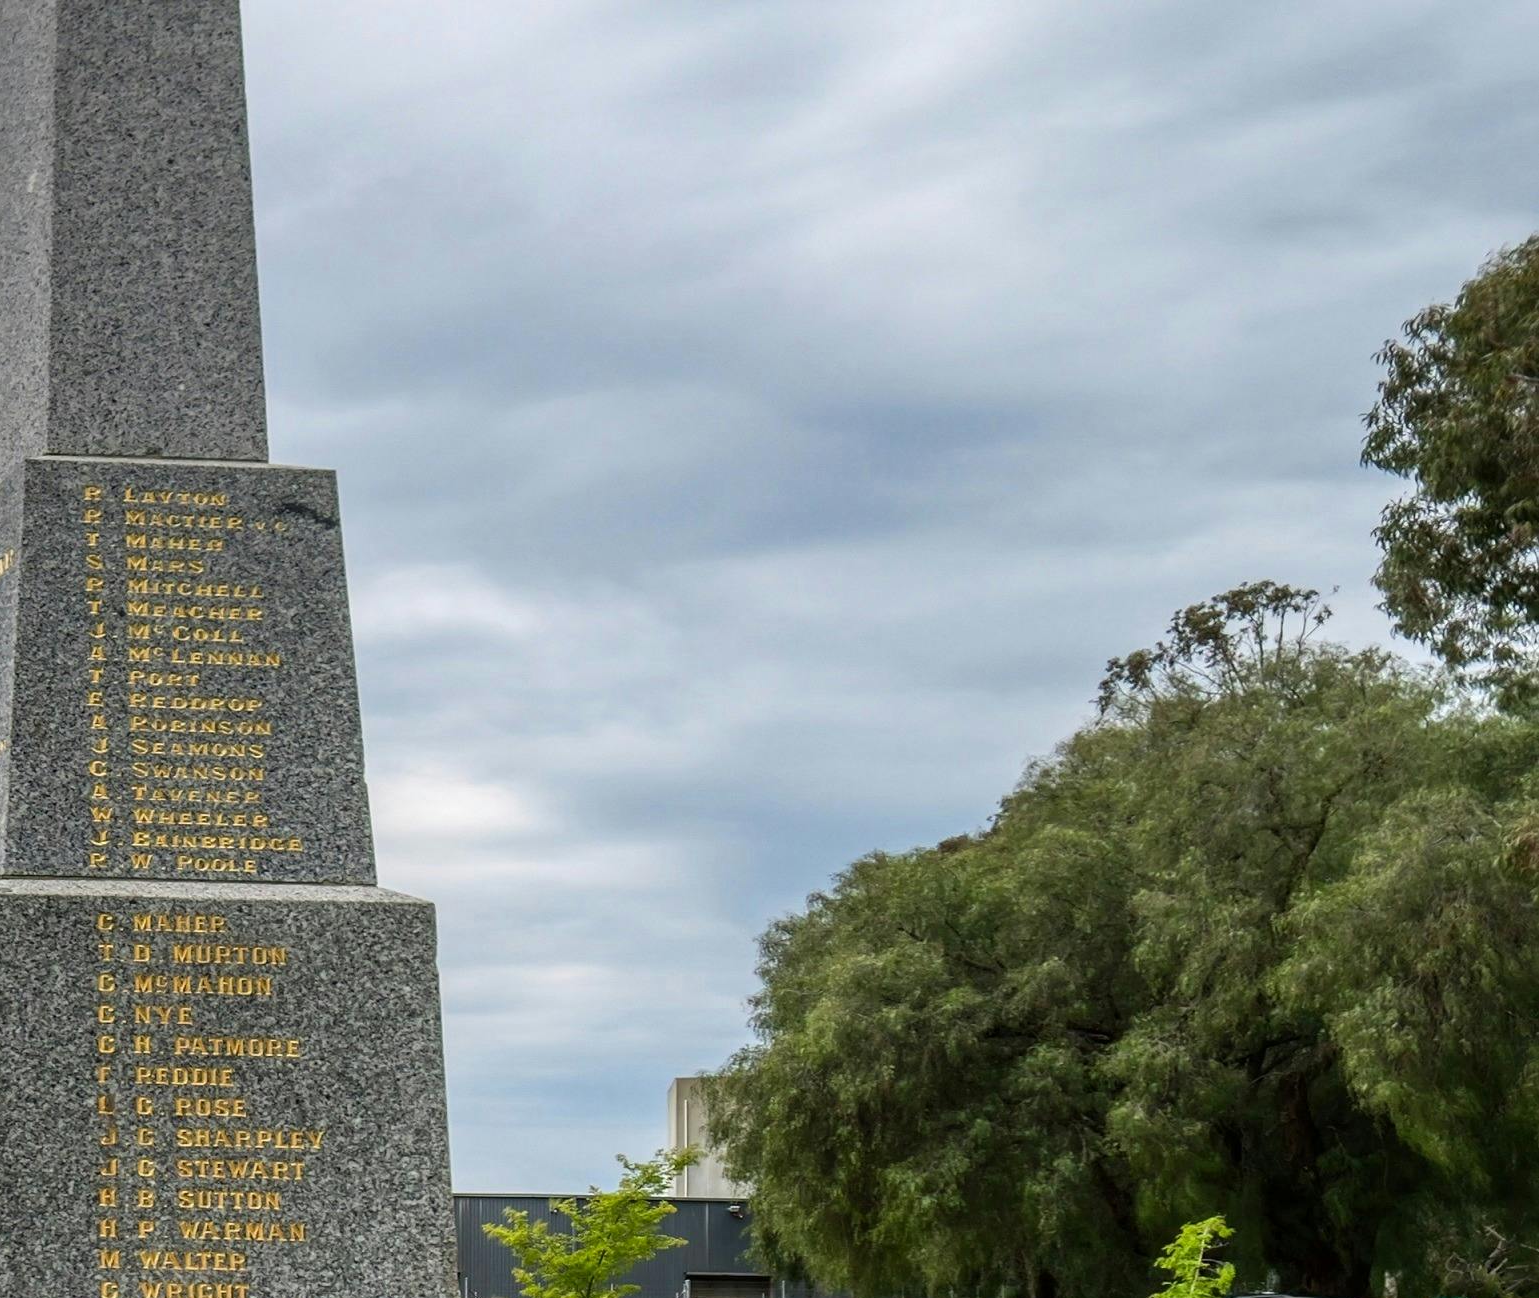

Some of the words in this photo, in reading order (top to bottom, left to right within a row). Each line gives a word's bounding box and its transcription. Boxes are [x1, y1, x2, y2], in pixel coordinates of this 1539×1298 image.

[124, 487, 228, 506] LAYTON
[125, 510, 244, 531] MACTIER
[126, 533, 224, 550] MAHER
[126, 556, 205, 574] MARS
[127, 579, 264, 598] MITCHELL
[127, 601, 264, 620] MEACHER
[127, 670, 201, 687] PORT
[128, 692, 264, 712] REDDROP
[129, 716, 272, 736] ROBINSON
[131, 738, 265, 759] SEAMONS
[131, 762, 264, 781] SWANSON
[131, 785, 261, 804] TAVENER
[133, 807, 269, 827] WHEELER
[132, 831, 304, 852] BAINBRIDGE
[177, 855, 258, 873] POOLE
[133, 914, 226, 933] MAHER
[173, 944, 287, 966] MURTON
[134, 1005, 193, 1025] NYE
[174, 1037, 301, 1057] PATMORE
[135, 1066, 234, 1087] REDDIE
[175, 1098, 247, 1118] ROSE
[176, 1128, 324, 1150] SHARPLEY
[176, 1159, 305, 1181] STEWART
[178, 1189, 282, 1210] SUTTON
[179, 1220, 307, 1242] WARMAN
[139, 1251, 247, 1271] WALTER
